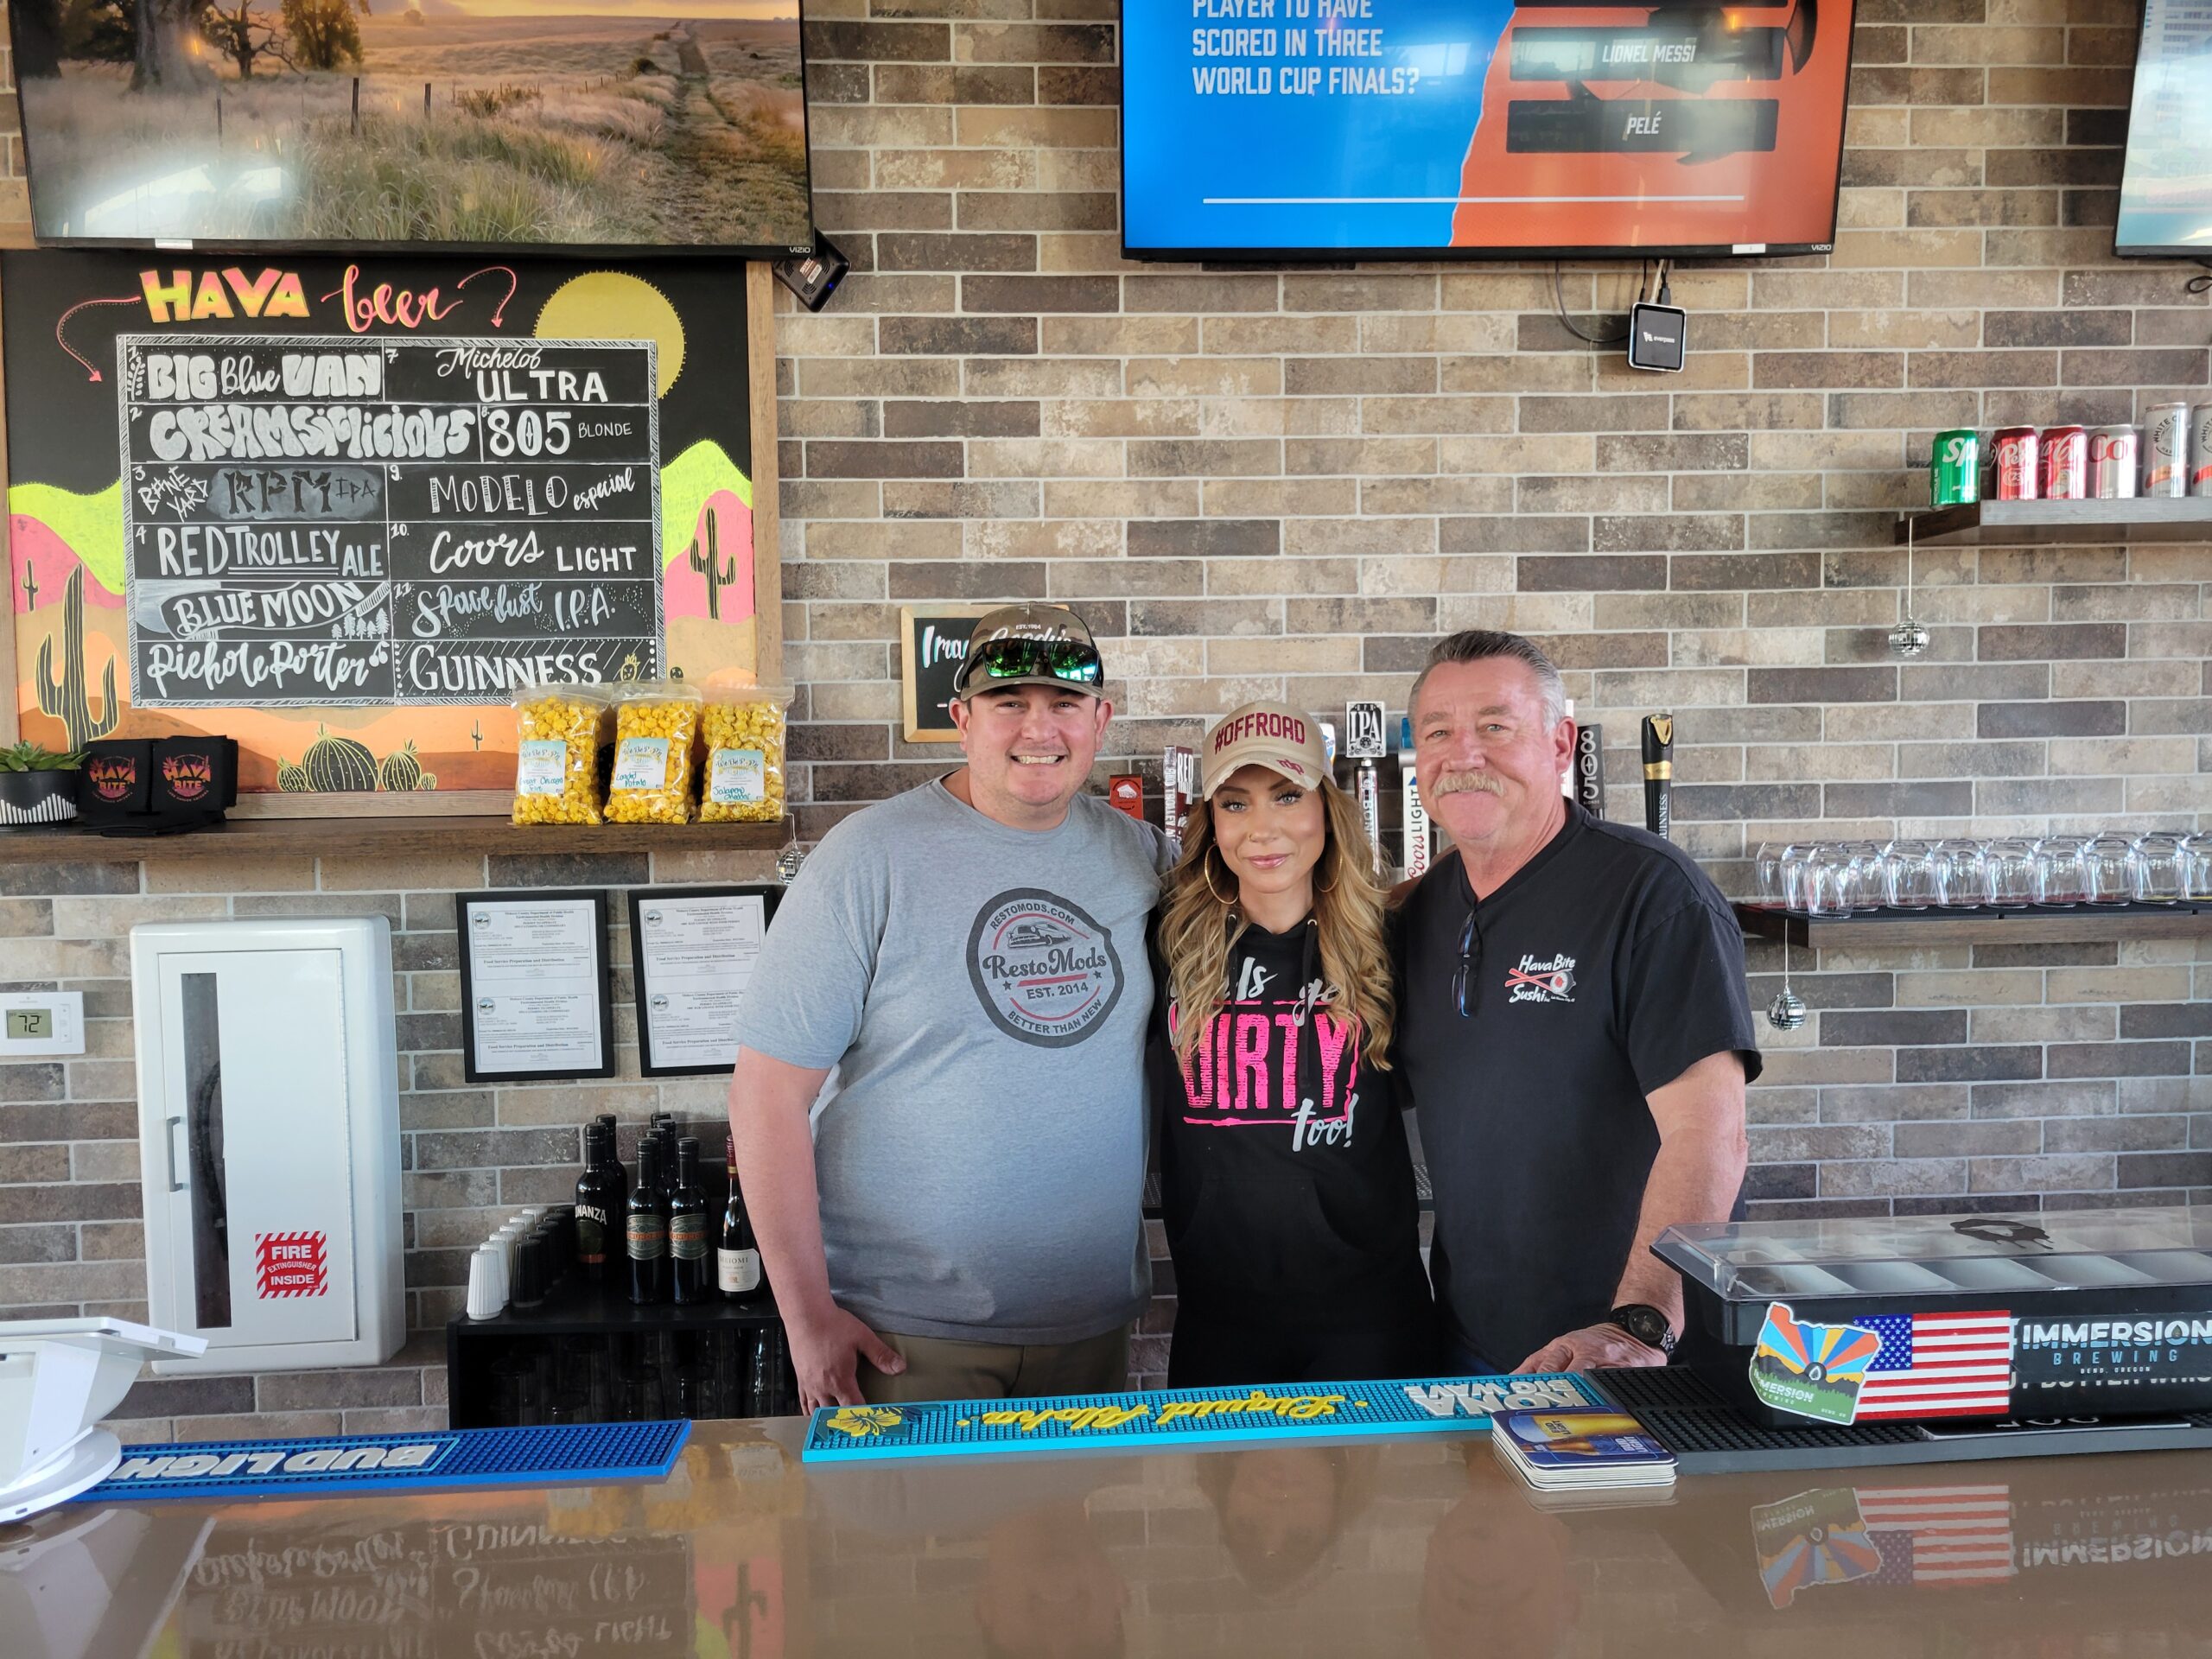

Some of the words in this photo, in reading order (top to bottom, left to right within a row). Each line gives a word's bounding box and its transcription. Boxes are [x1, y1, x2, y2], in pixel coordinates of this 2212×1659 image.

[1192, 0, 1274, 18] PLAYER
[1285, 0, 1310, 18] TO
[1317, 0, 1373, 18] HAVE
[1192, 29, 1277, 57] SCORED
[1284, 29, 1307, 57] IN
[1313, 29, 1383, 57] THREE
[1602, 45, 1649, 63] LIONEL
[1652, 45, 1696, 63] MESSI
[1192, 67, 1272, 95] WORLD
[1279, 67, 1322, 95] CUP
[1328, 67, 1421, 95] FINALS?
[1626, 111, 1662, 135] PELÉ
[139, 267, 310, 323] HAVA
[321, 264, 463, 333] beer
[147, 354, 217, 400] BIG
[221, 354, 281, 395] Blue
[281, 353, 381, 397] VAN
[436, 347, 542, 378] Michelob
[476, 370, 608, 403] ULTRA
[486, 410, 572, 457] 805
[578, 422, 632, 439] BLONDE
[223, 470, 332, 514] RPM
[429, 475, 567, 516] MODELO
[573, 467, 635, 511] especial
[157, 525, 229, 576] RED
[226, 525, 340, 566] TROLLEY
[342, 544, 384, 577] ALE
[429, 531, 544, 575] Coors
[556, 546, 637, 572] LIGHT
[173, 592, 257, 636] BLUE
[260, 582, 365, 627] MOON
[147, 640, 269, 698] Piehole
[270, 641, 369, 691] Porter
[410, 645, 602, 690] GUINNESS
[1214, 712, 1306, 754] #OFFROAD
[1351, 711, 1381, 742] IPA
[162, 764, 211, 782] HAVA
[1178, 753, 1192, 783] RED
[1580, 730, 1599, 799] 805
[99, 781, 126, 790] BITE
[174, 780, 202, 789] BITE
[1411, 789, 1421, 832] LIGHT
[1408, 835, 1425, 879] Coors
[990, 903, 1075, 930] RESTOMODS.COM
[982, 947, 1107, 979] RestoMods
[1518, 955, 1553, 974] Hava
[1553, 953, 1575, 970] Bite
[1027, 988, 1054, 1000] EST.
[1058, 982, 1089, 995] 2014
[1509, 983, 1547, 1002] Sushi
[18, 1015, 40, 1033] 72
[1008, 1011, 1050, 1033] BETTER
[1053, 1019, 1081, 1033] THAN
[1082, 999, 1102, 1022] NEW
[1181, 1013, 1350, 1109] DIRTY
[1291, 1093, 1359, 1152] too!
[271, 1245, 312, 1260] FIRE
[267, 1262, 316, 1273] EXTINGUISHER
[270, 1274, 315, 1286] INSIDE
[2022, 1319, 2212, 1351] IMMERSION
[2053, 1350, 2178, 1365] BREWING
[1404, 1382, 1509, 1399] WAVE
[1510, 1379, 1576, 1395] BIG
[982, 1403, 1150, 1432] Aloha
[1155, 1390, 1345, 1426] Liquid
[1413, 1390, 1590, 1417] KONA
[1545, 1421, 1561, 1433] BUD
[1553, 1420, 1572, 1435] LIGHT
[283, 1444, 438, 1472] BUD
[1614, 1437, 1632, 1452] BUD
[1627, 1435, 1649, 1452] LIGHT
[108, 1451, 286, 1480] LIGH
